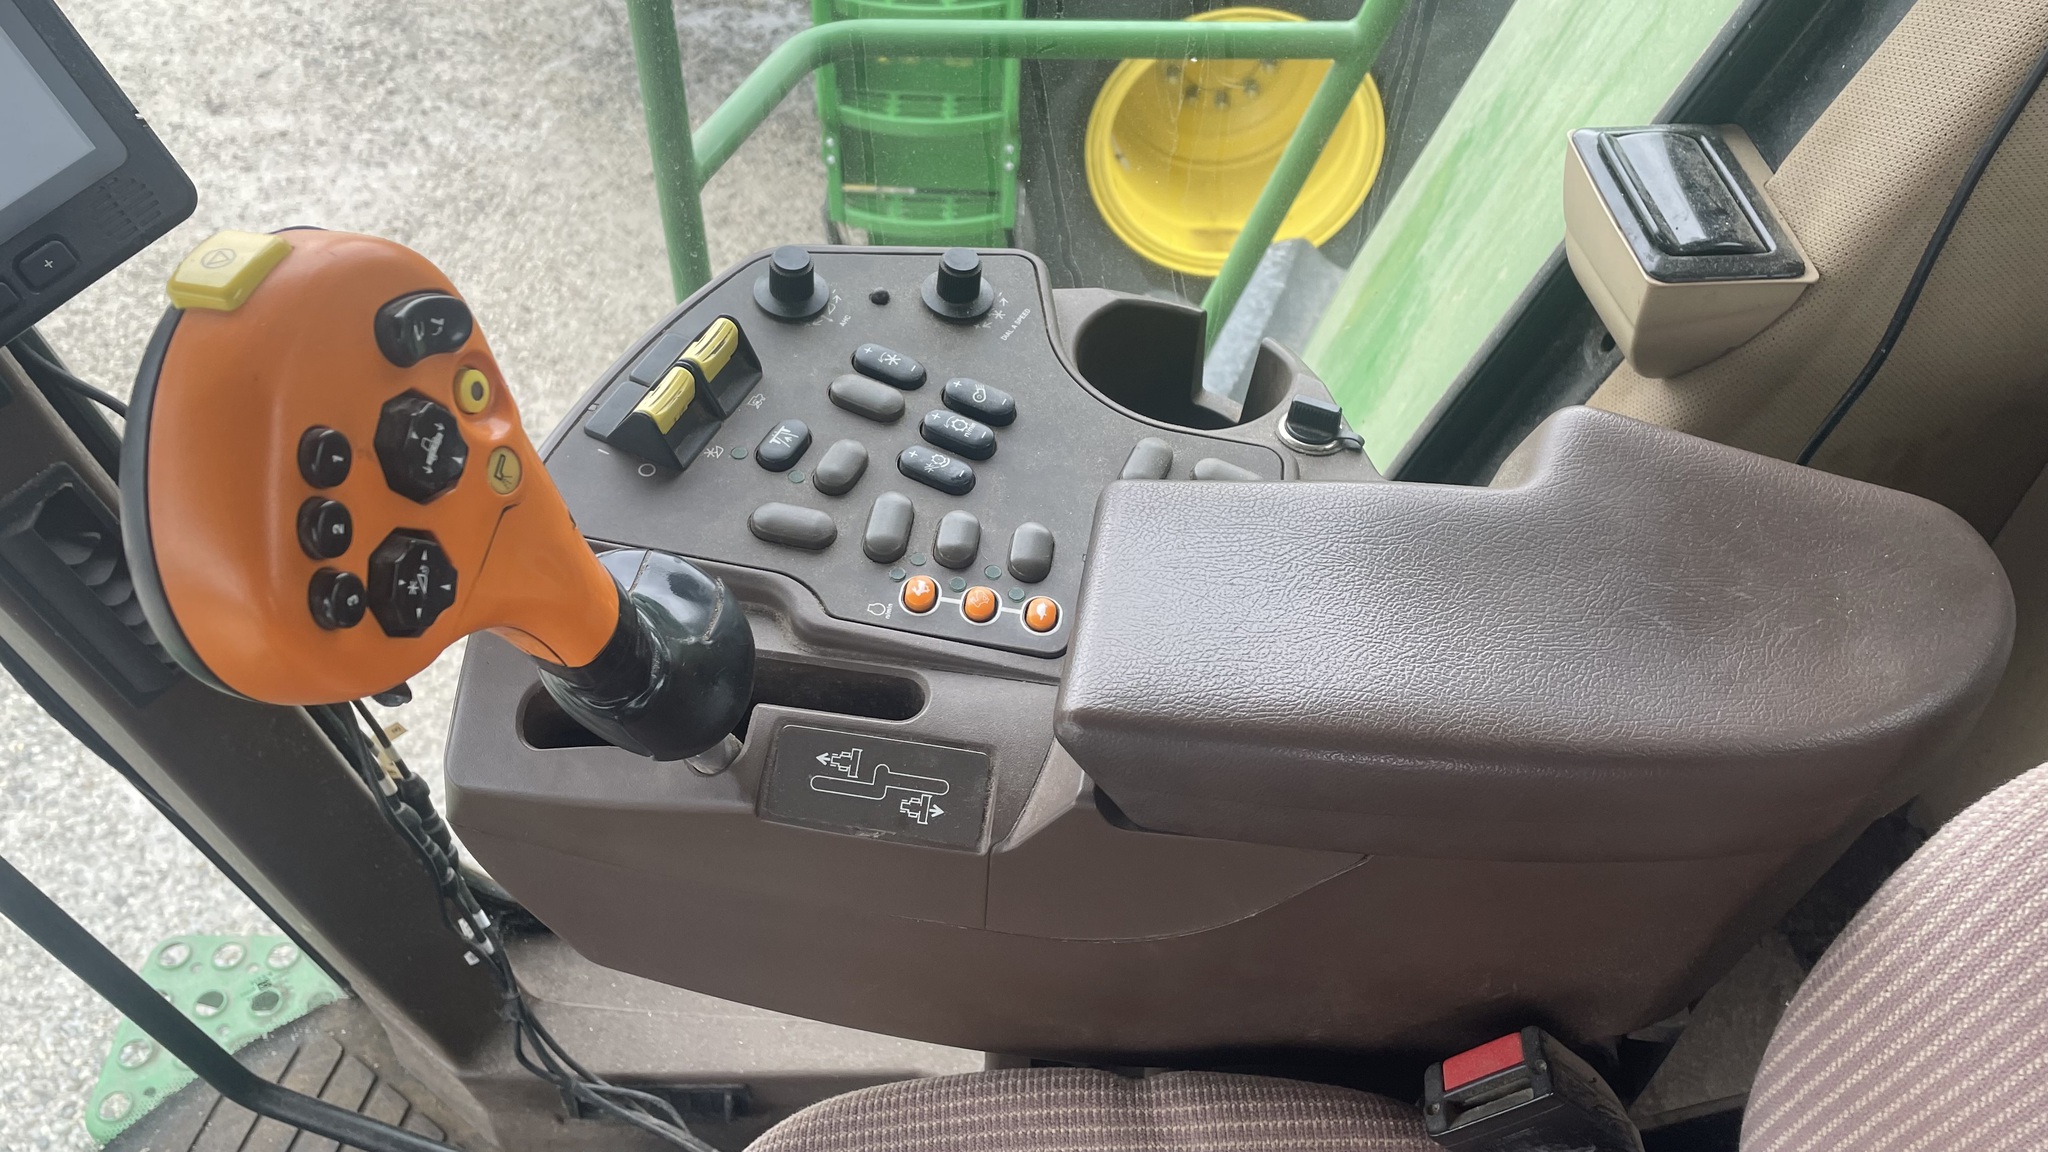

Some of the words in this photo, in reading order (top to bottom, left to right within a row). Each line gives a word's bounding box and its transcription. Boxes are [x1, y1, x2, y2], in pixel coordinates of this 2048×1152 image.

[839, 314, 851, 327] AHC
[1000, 330, 1014, 341] DIAL
[1014, 308, 1031, 325] SPEED
[331, 454, 344, 463] 1
[331, 523, 345, 535] 2
[346, 594, 359, 607] 3
